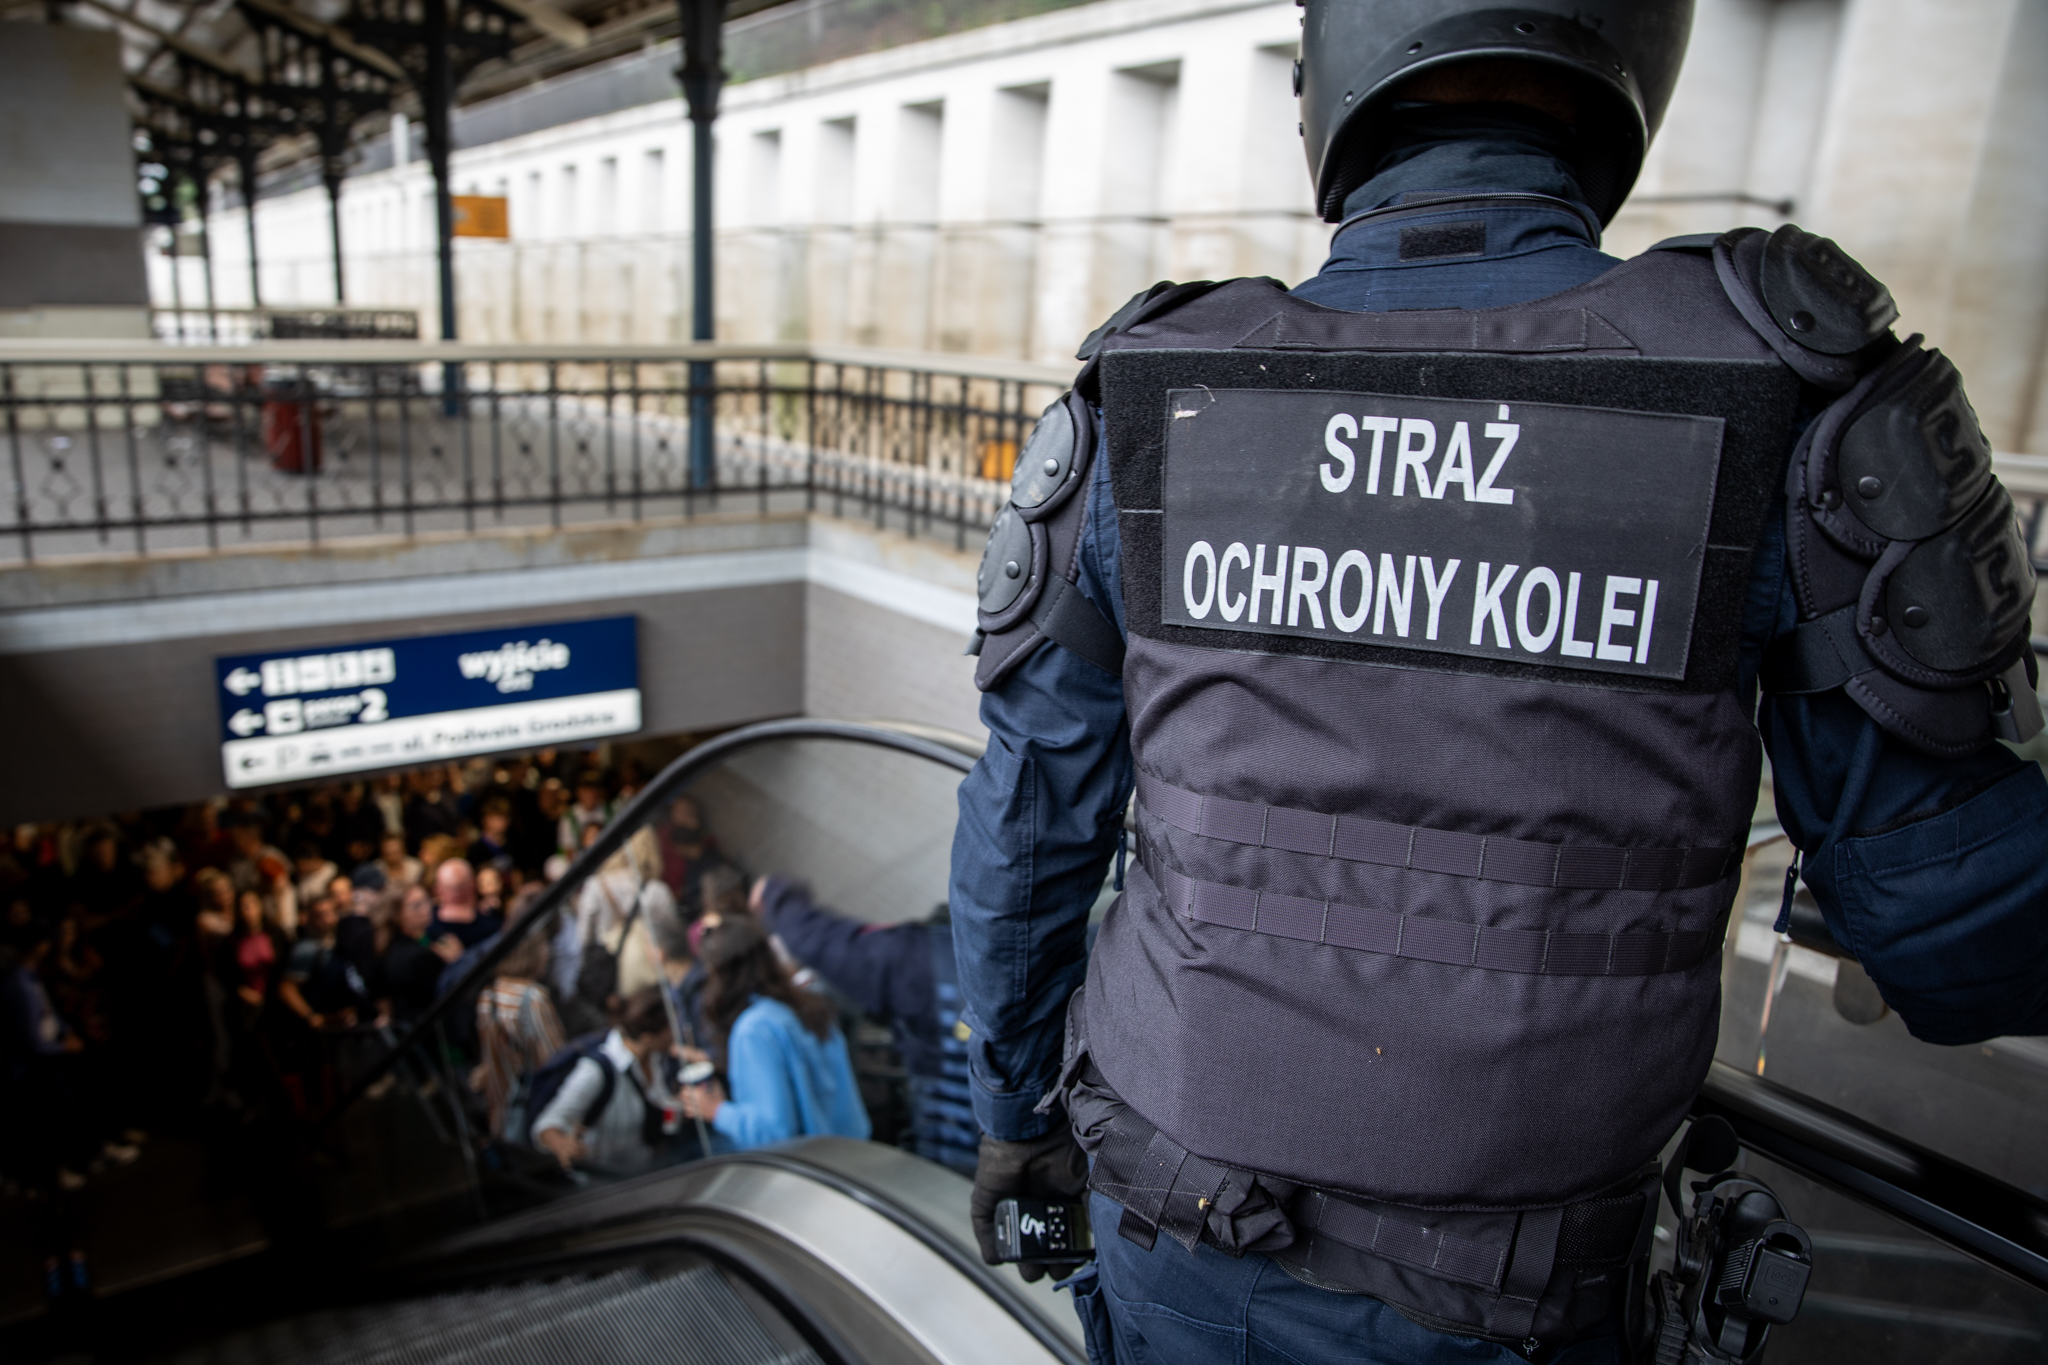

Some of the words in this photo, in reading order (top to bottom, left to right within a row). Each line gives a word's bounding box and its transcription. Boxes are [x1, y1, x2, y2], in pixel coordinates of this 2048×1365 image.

[1319, 403, 1520, 505] STRAŻ
[1183, 540, 1461, 641] OCHRONY
[1469, 561, 1659, 665] KOLEI
[358, 687, 389, 722] 2
